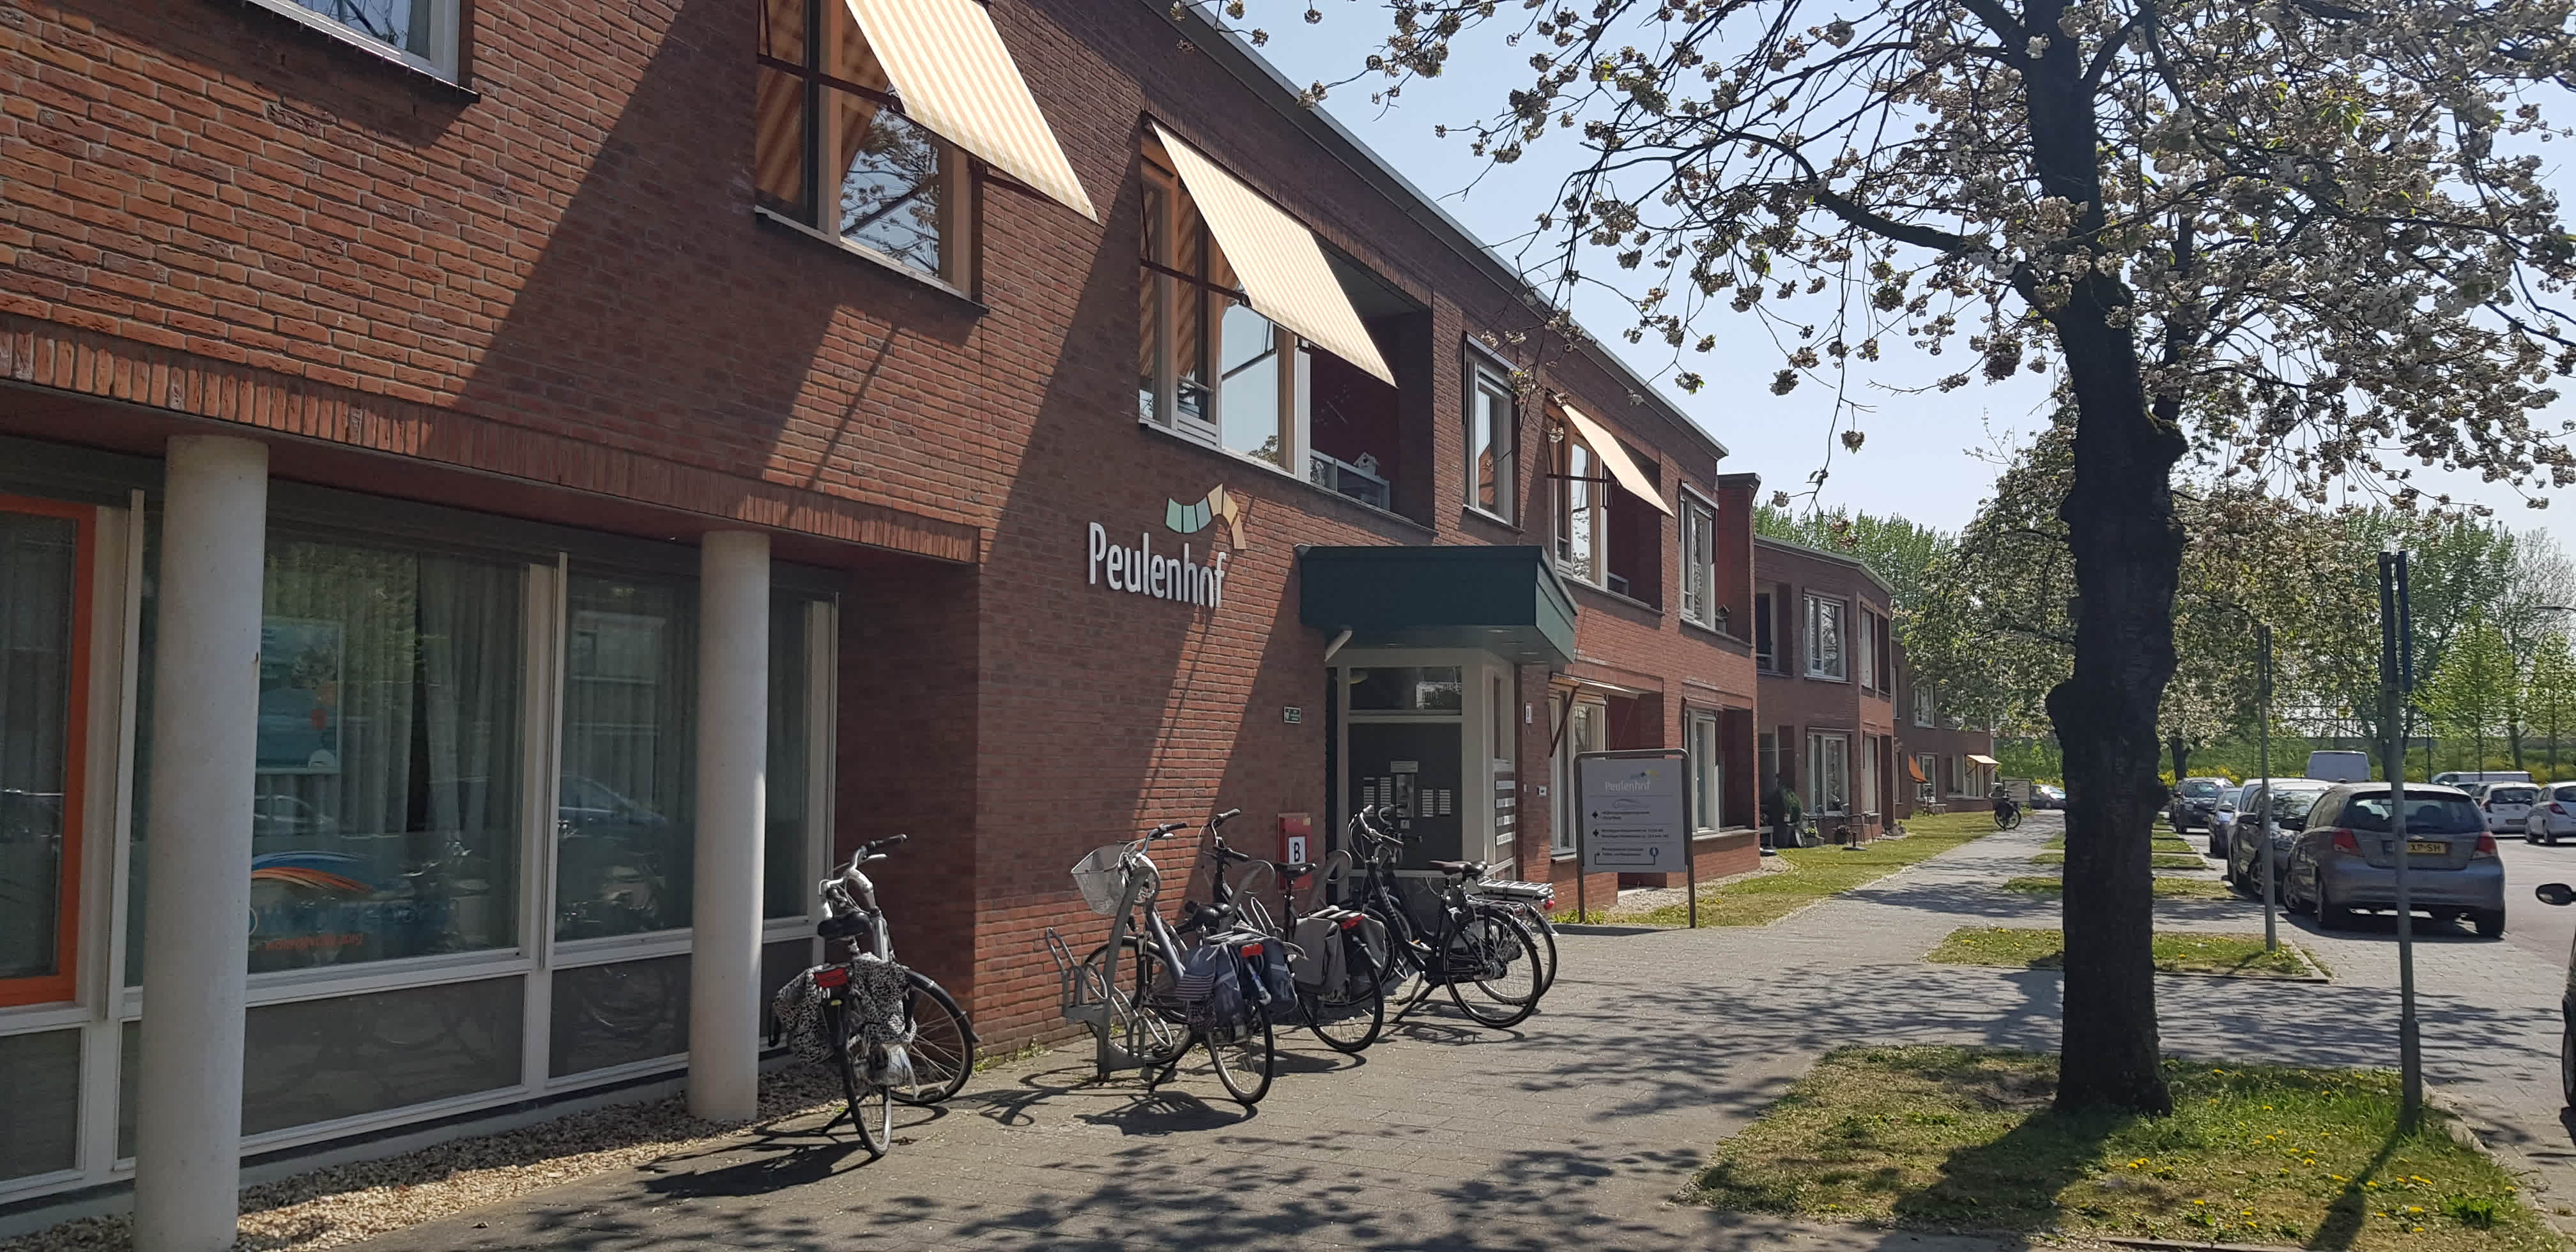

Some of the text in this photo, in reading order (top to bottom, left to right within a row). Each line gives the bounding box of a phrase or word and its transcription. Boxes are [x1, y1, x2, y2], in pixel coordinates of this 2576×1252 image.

[1089, 521, 1227, 608] Peulenhof
[1604, 780, 1651, 792] Peulenhof
[1294, 842, 1301, 862] B
